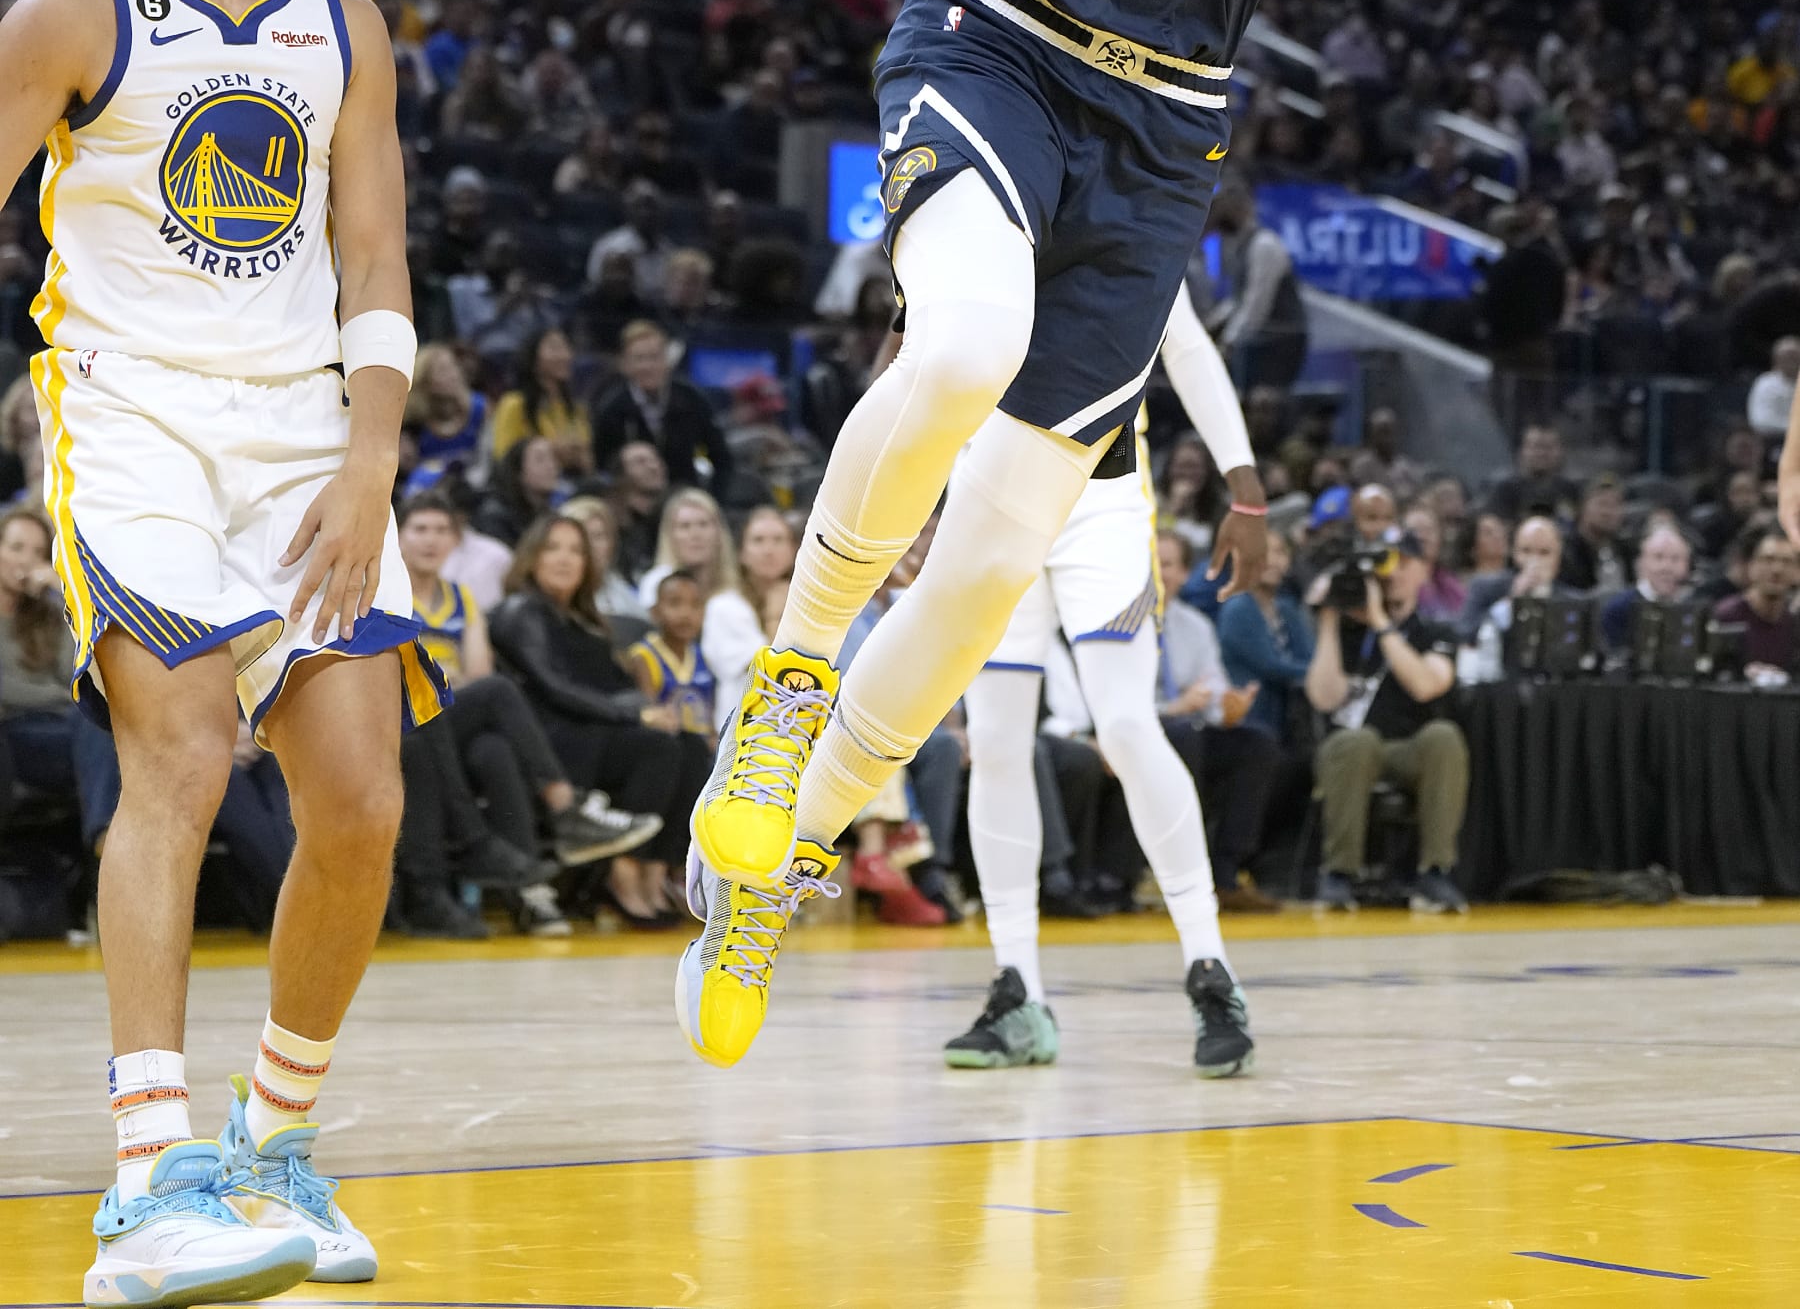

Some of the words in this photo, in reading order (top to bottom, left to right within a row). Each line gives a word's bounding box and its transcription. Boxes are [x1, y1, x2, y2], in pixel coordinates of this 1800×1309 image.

[271, 31, 328, 47] Rakuten
[166, 73, 251, 120] GOLDEN
[262, 78, 316, 128] STATE
[263, 136, 286, 178] 11
[158, 213, 305, 279] WARRIORS
